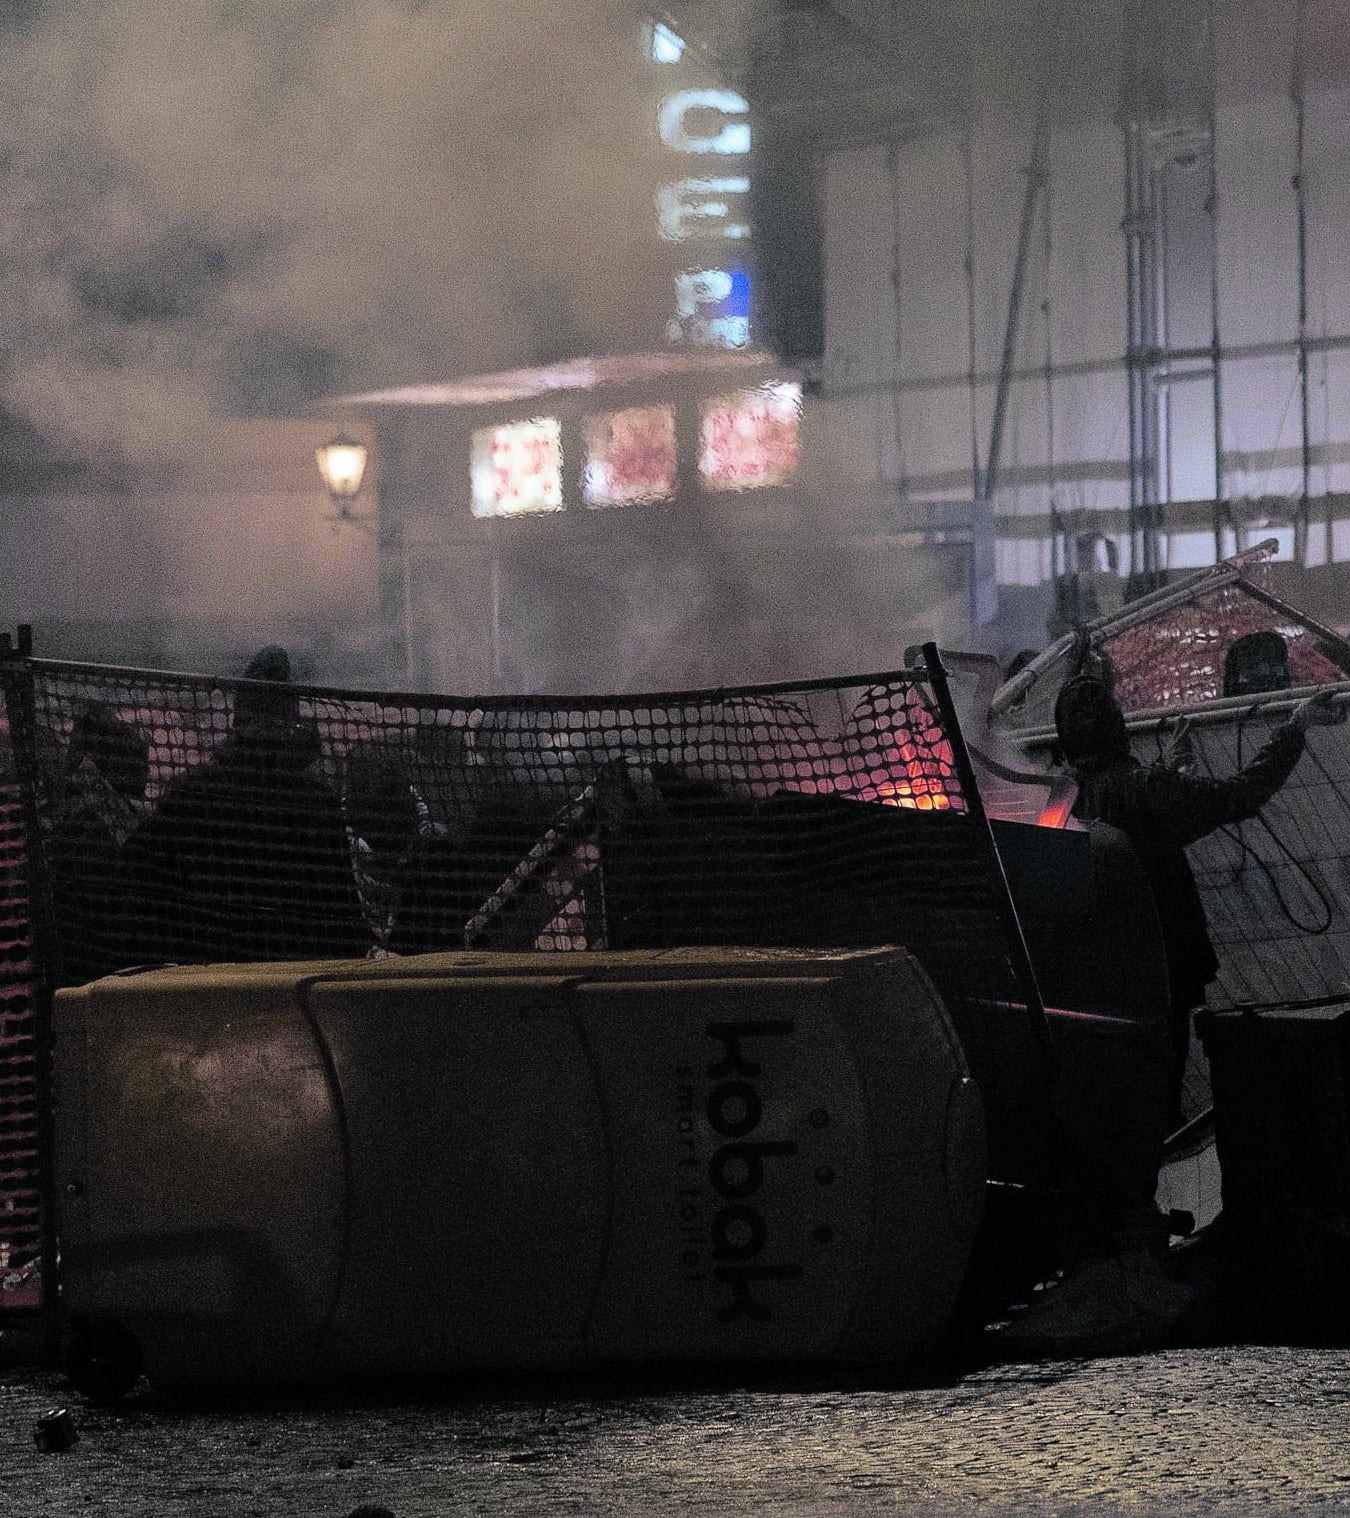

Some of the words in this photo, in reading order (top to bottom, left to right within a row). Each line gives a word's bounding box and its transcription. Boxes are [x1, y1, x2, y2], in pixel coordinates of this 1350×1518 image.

[676, 1065, 700, 1168] smart
[705, 1019, 803, 1324] kobak
[678, 1188, 705, 1284] toilet
